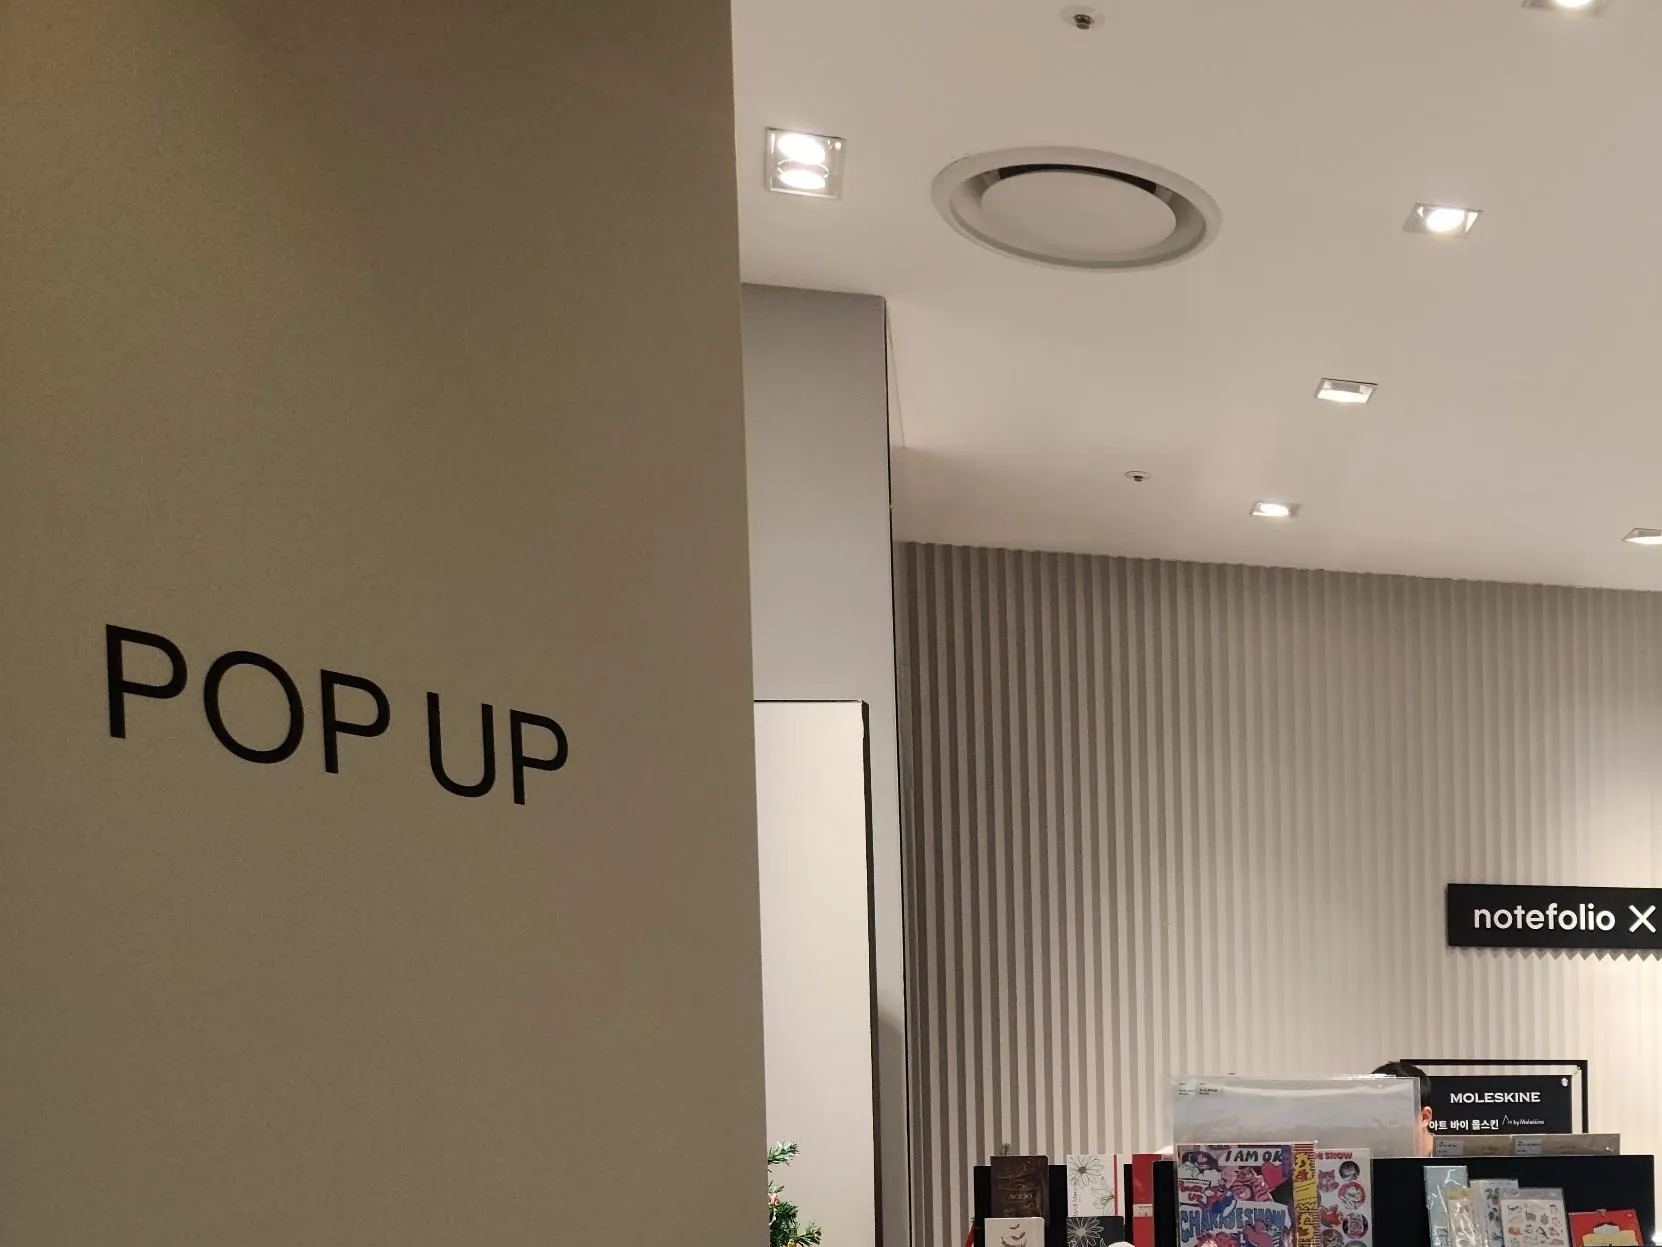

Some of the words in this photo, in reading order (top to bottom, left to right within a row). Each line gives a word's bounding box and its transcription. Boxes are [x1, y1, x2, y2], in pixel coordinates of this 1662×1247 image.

[106, 623, 390, 775] POP
[427, 691, 569, 806] UP
[1473, 903, 1616, 931] notefolio
[1629, 905, 1656, 933] X
[1450, 1092, 1541, 1104] MOLESKINE
[1429, 1119, 1448, 1131] 아트
[1450, 1119, 1469, 1131] 바이
[1472, 1119, 1499, 1131] 몰스킨
[1234, 1150, 1258, 1162] AM
